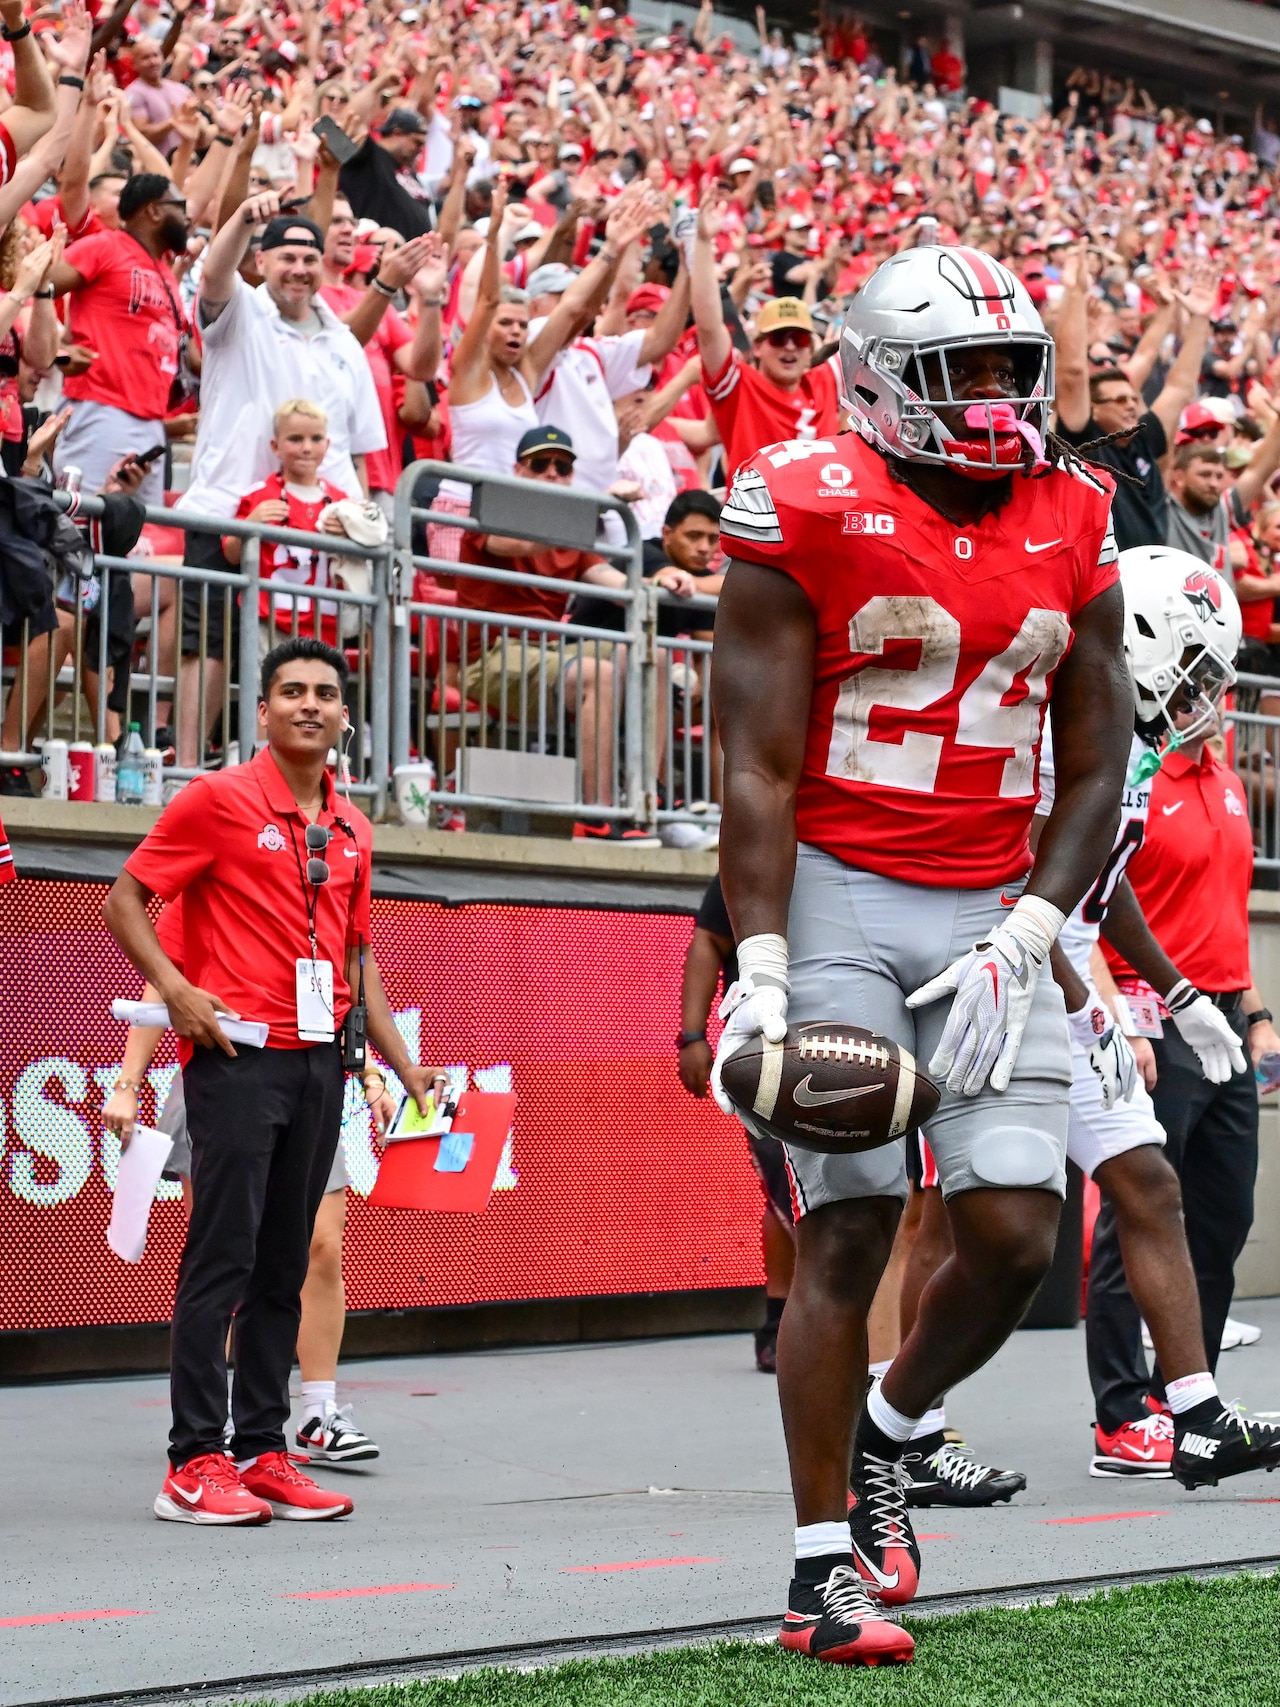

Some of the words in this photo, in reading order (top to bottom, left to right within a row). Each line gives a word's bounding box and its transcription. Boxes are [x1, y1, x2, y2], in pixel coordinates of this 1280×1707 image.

[818, 488, 858, 497] CHASE
[824, 595, 1071, 799] 24
[1178, 1431, 1222, 1460] NIKE
